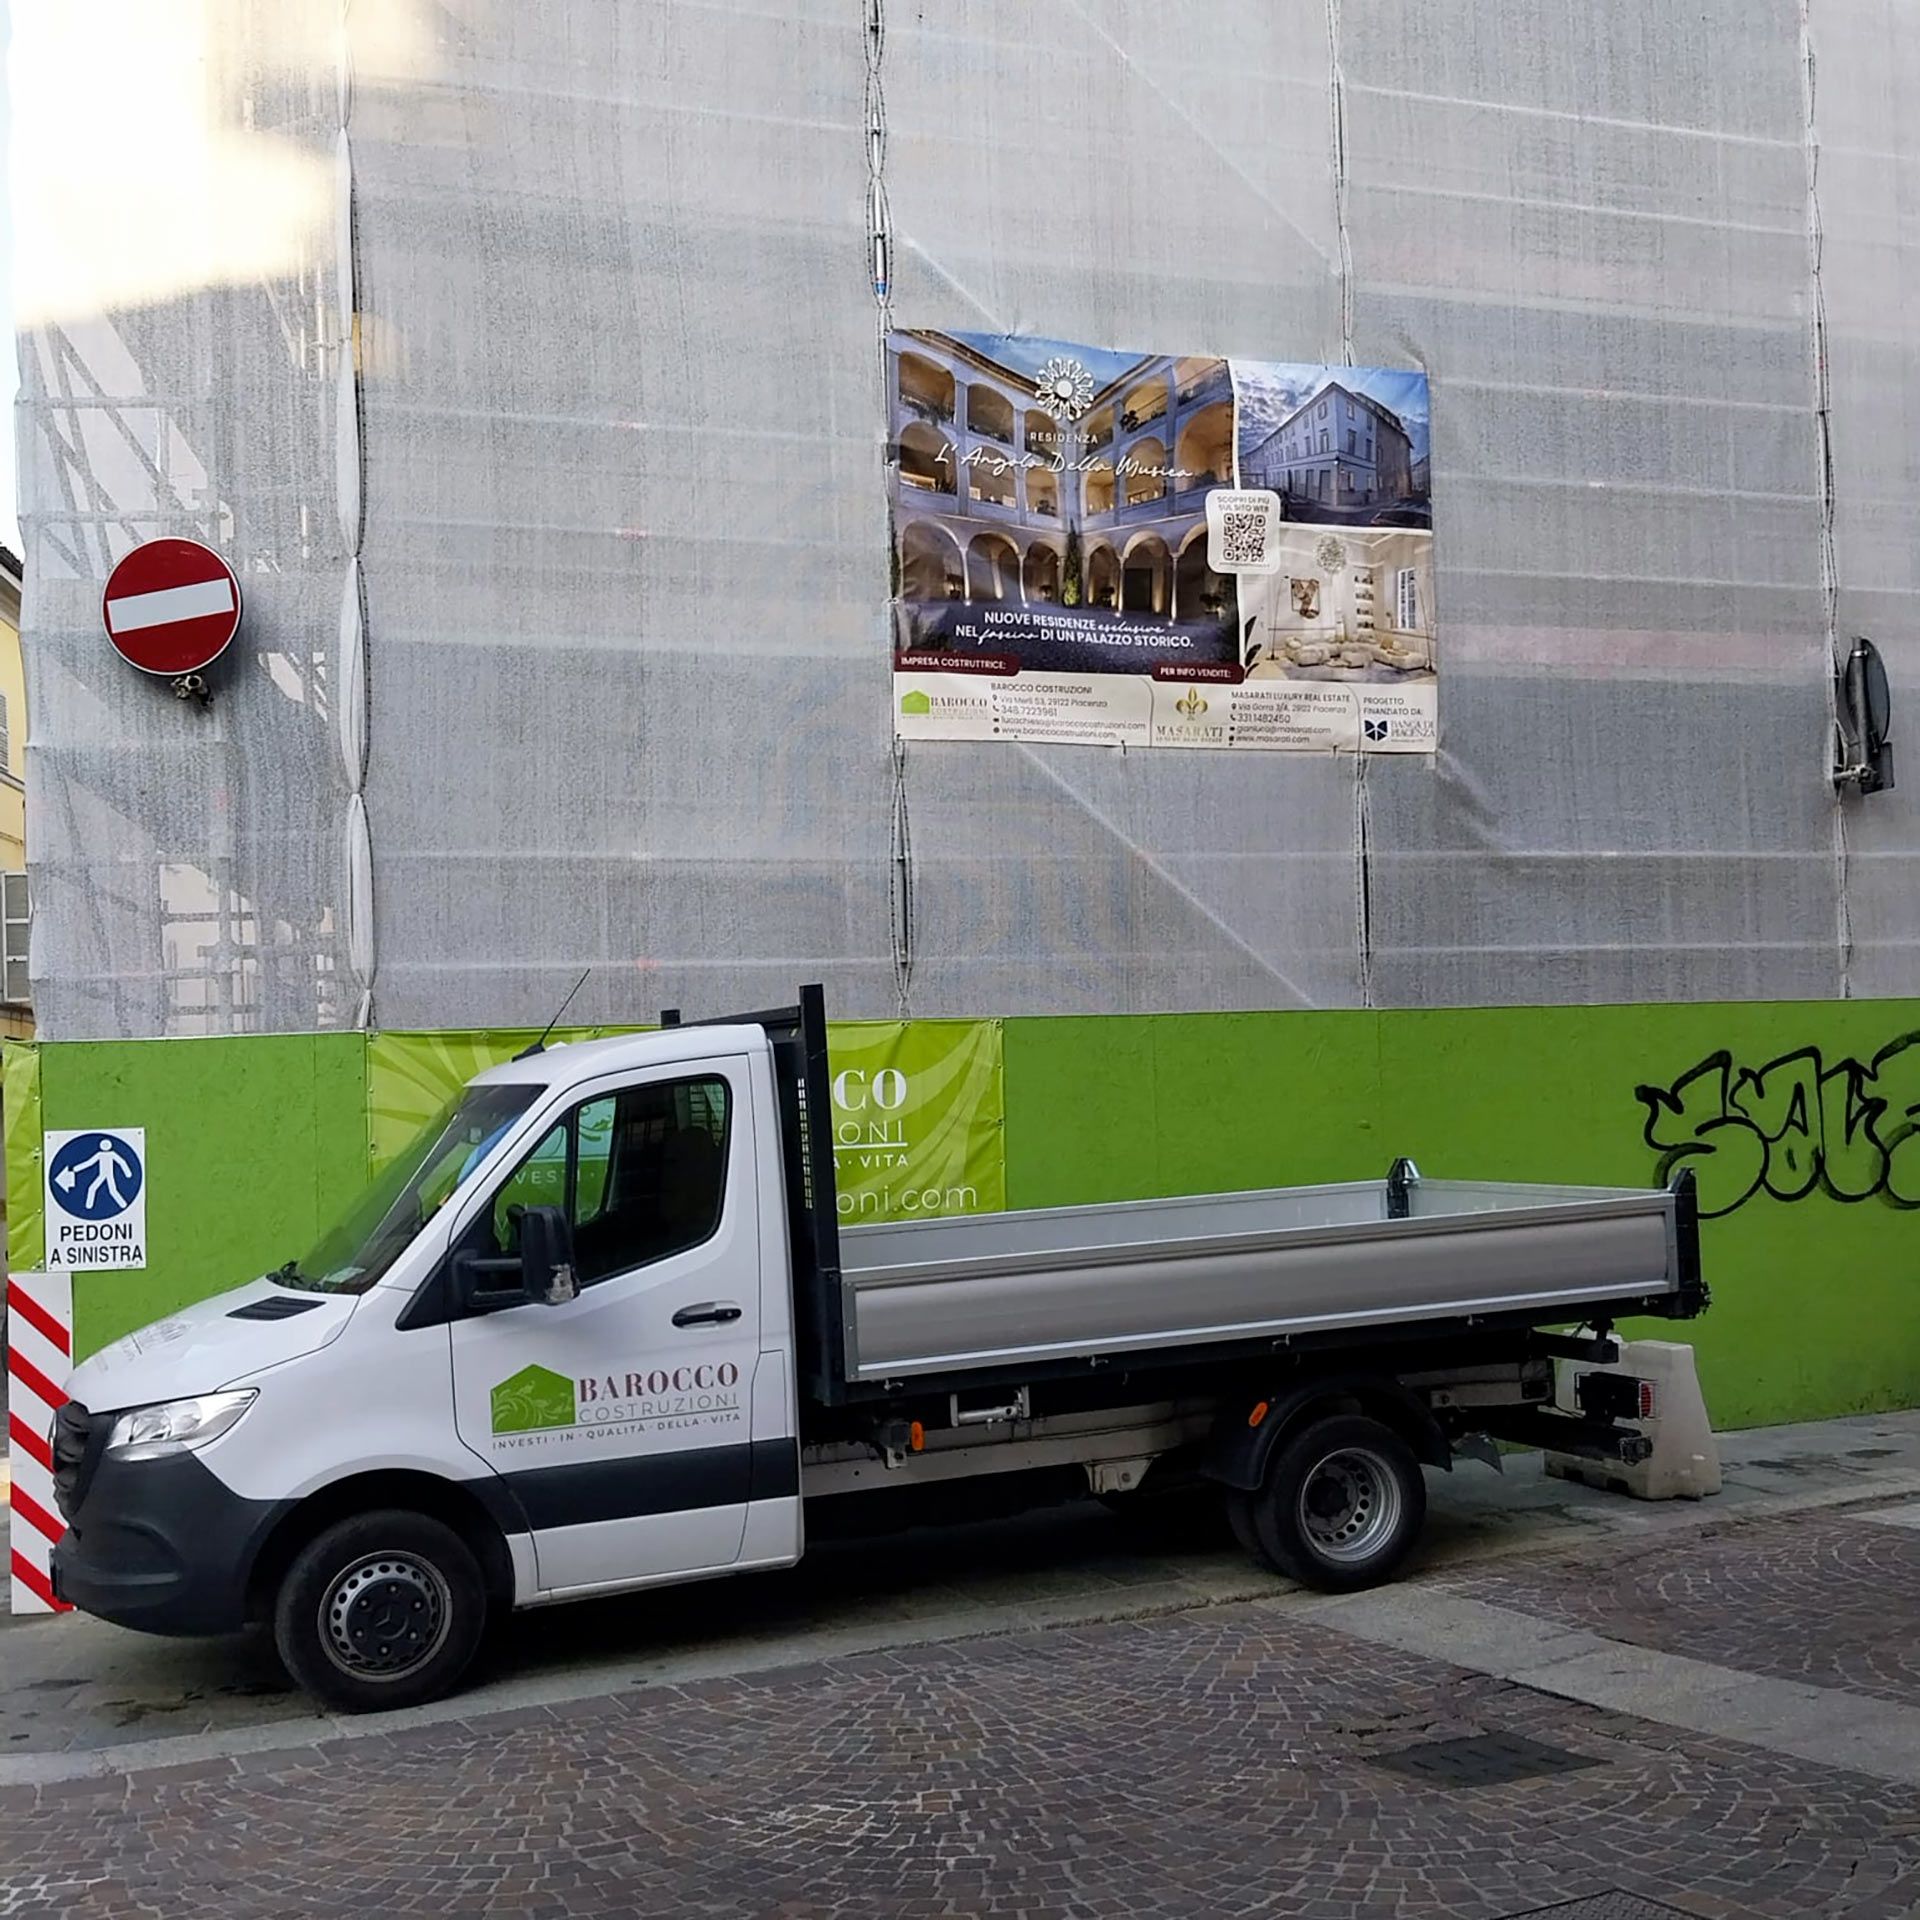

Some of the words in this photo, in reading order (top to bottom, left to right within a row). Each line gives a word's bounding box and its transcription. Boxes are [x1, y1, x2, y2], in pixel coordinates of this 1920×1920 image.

[1030, 432, 1098, 444] RESIDENZA
[1047, 451, 1113, 473] Della
[1115, 455, 1195, 479] Musica
[984, 611, 1031, 626] NUOVE
[1033, 614, 1096, 631] RESIDENZE
[955, 624, 978, 638] NEL
[1041, 628, 1055, 641] DI
[1057, 629, 1076, 642] UN
[1077, 631, 1132, 646] PALAZZO
[1134, 634, 1194, 648] STORICO.
[901, 656, 940, 667] IMPRESA
[941, 658, 1007, 670] COSTRUTTRICE:
[1160, 666, 1176, 676] PER
[1176, 667, 1196, 677] INFO
[1197, 668, 1232, 679] VENDITE:
[991, 682, 1034, 693] BAROCCO
[1035, 684, 1094, 695] COSTRUZIONI
[930, 696, 988, 708] BAROCCO
[1231, 691, 1272, 700] MASARATI
[1273, 692, 1303, 701] LUXURY
[1304, 693, 1322, 702] REAL
[1323, 694, 1351, 703] ESTATE
[1363, 696, 1405, 706] PROGETTO
[1070, 699, 1108, 709] Piacenza
[1363, 707, 1409, 716] FINANZIATO
[1002, 727, 1118, 739] www.baroccocostruzioni.com
[1156, 725, 1223, 737] MASARATI
[860, 1154, 909, 1169] VITA
[60, 1223, 132, 1243] PEDONI
[50, 1248, 61, 1265] A
[66, 1244, 143, 1265] SINISTRA
[579, 1361, 739, 1404] BAROCCO
[578, 1391, 737, 1423] COSTRUZIONI
[492, 1435, 549, 1451] INVESTI
[559, 1432, 575, 1442] IN
[586, 1423, 646, 1440] QUALITÀ
[657, 1416, 700, 1431] DELLA
[709, 1412, 741, 1425] VITA
